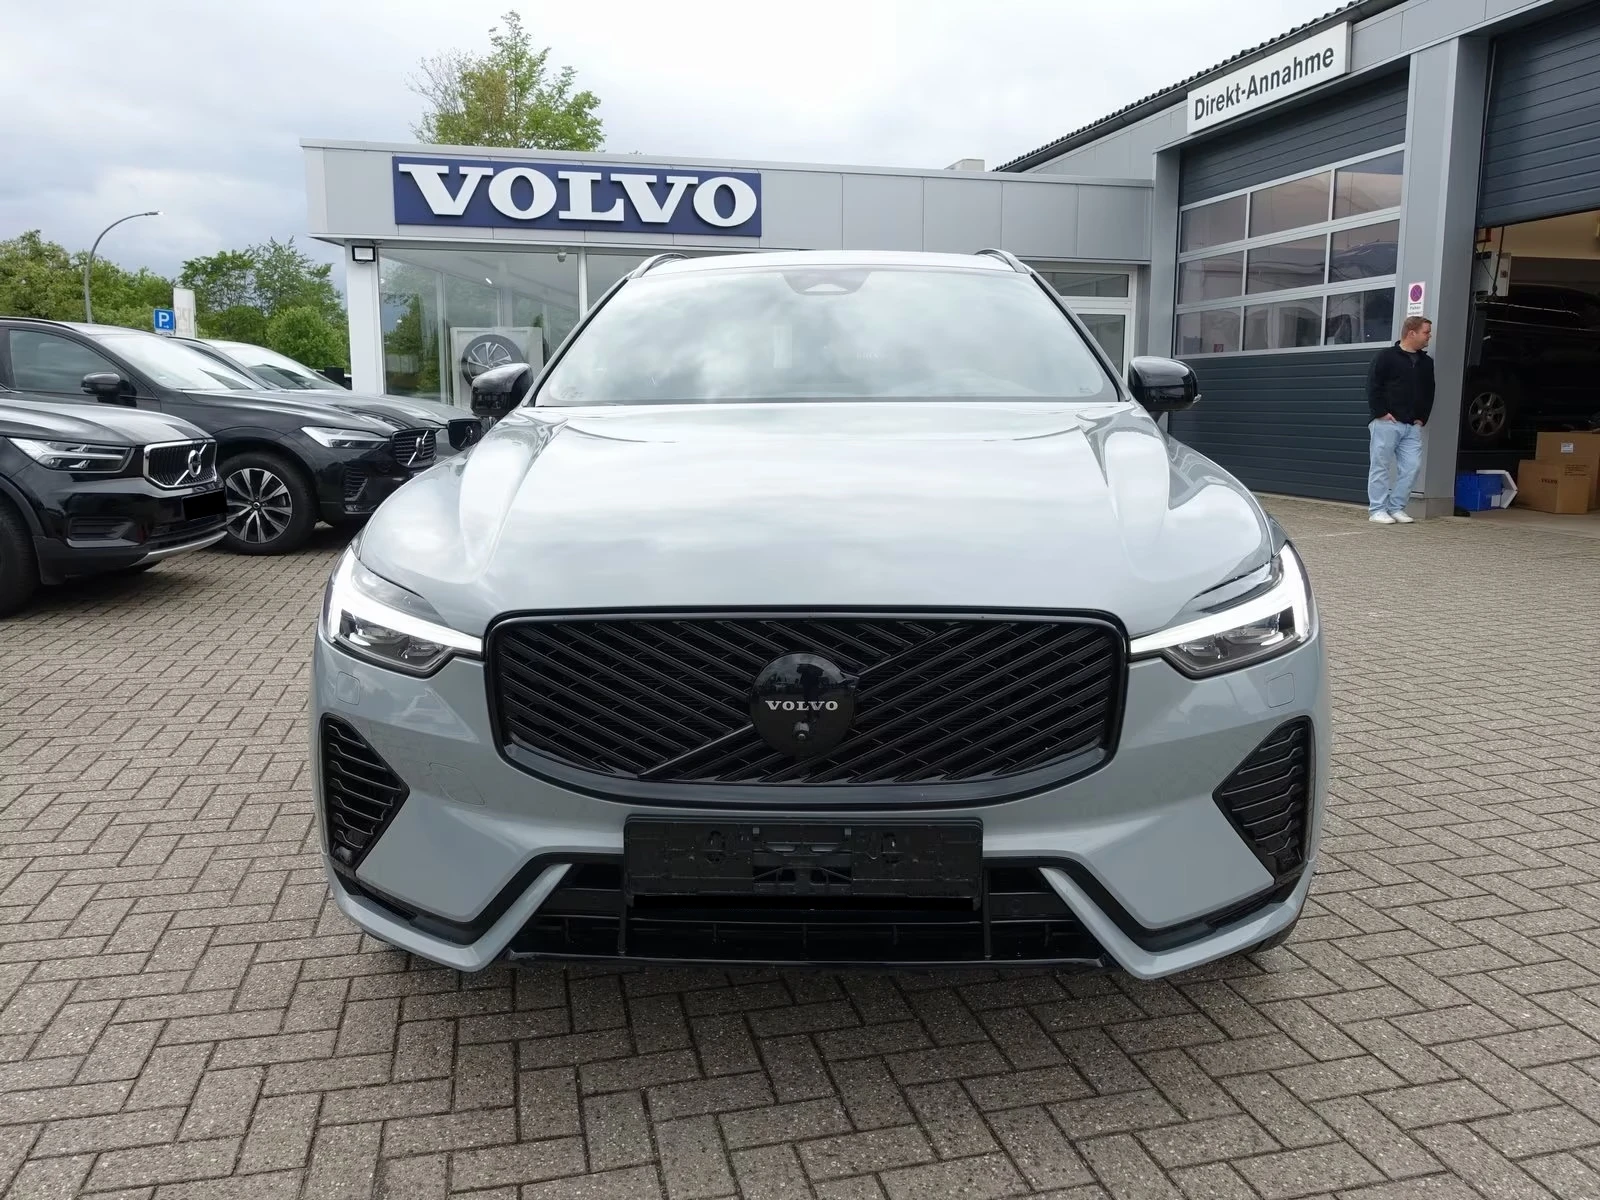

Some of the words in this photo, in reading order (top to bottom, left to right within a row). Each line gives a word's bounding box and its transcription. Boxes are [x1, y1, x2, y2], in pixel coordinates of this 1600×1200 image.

[1194, 47, 1334, 121] Direkt-Annahme
[398, 163, 757, 228] VOLVO
[158, 311, 170, 328] P
[765, 700, 839, 711] VOLVO
